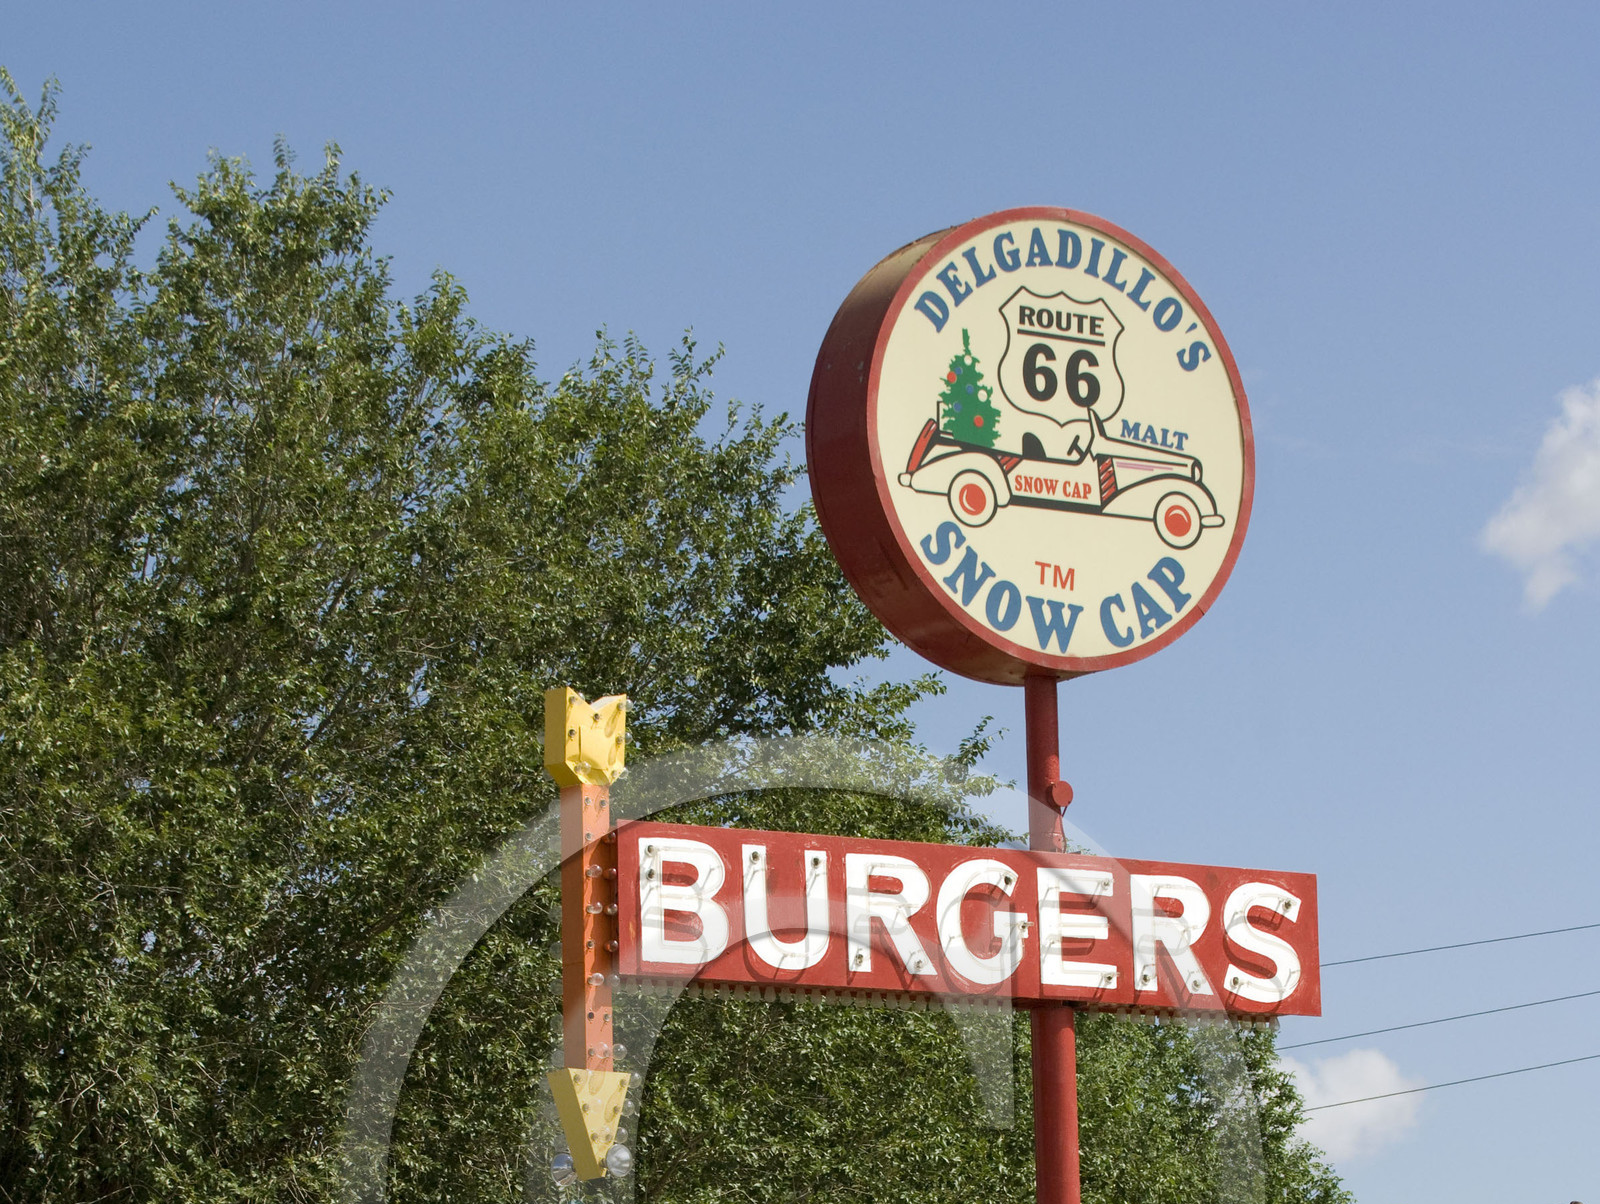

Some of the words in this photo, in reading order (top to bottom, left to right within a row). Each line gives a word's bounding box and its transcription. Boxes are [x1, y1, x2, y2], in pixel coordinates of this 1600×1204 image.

[914, 227, 1212, 373] DELGADILLO'S
[1018, 304, 1105, 337] ROUTE
[1022, 342, 1101, 409] 66
[1120, 418, 1189, 451] MALT
[1014, 473, 1060, 496] SNOW
[1062, 480, 1092, 501] CAP
[920, 520, 1084, 654] SNOW
[1099, 556, 1193, 649] CAP
[1034, 560, 1076, 592] TM
[638, 836, 1302, 1004] BURGERS
